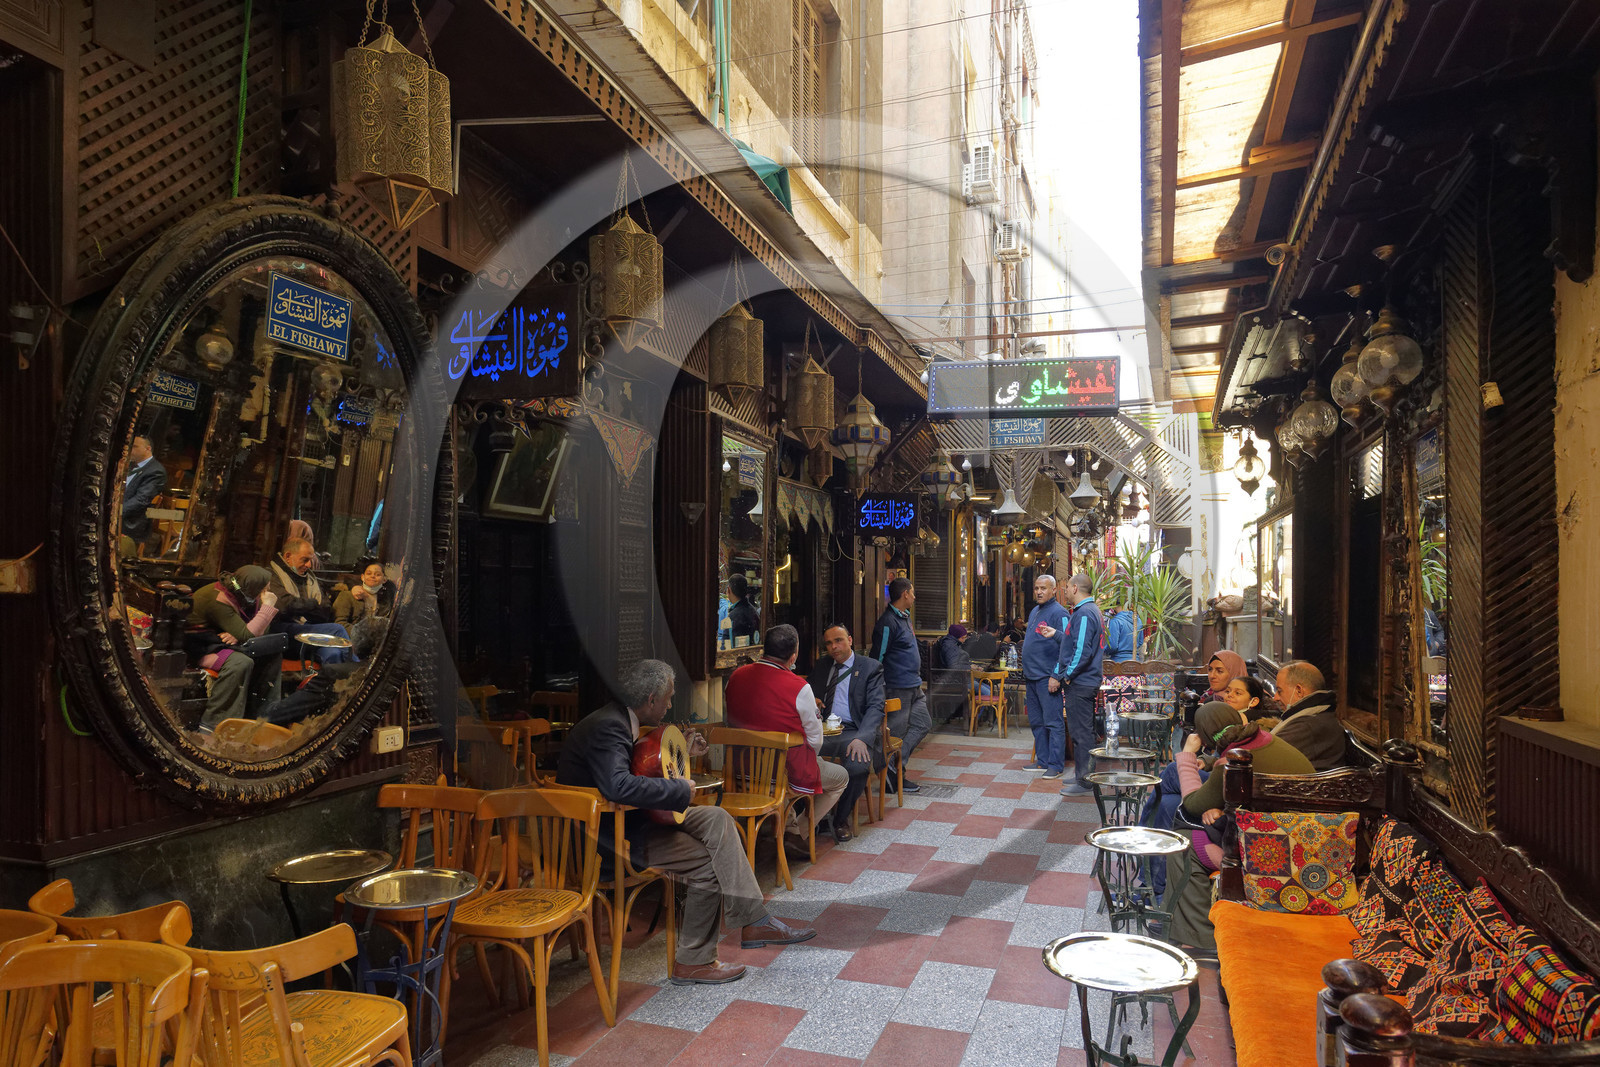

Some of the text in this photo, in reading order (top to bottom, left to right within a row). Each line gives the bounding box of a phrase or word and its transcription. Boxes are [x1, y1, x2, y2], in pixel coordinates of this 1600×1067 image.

[273, 324, 343, 356] EL FISHAWY
[990, 435, 1042, 445] EL FISHAWY
